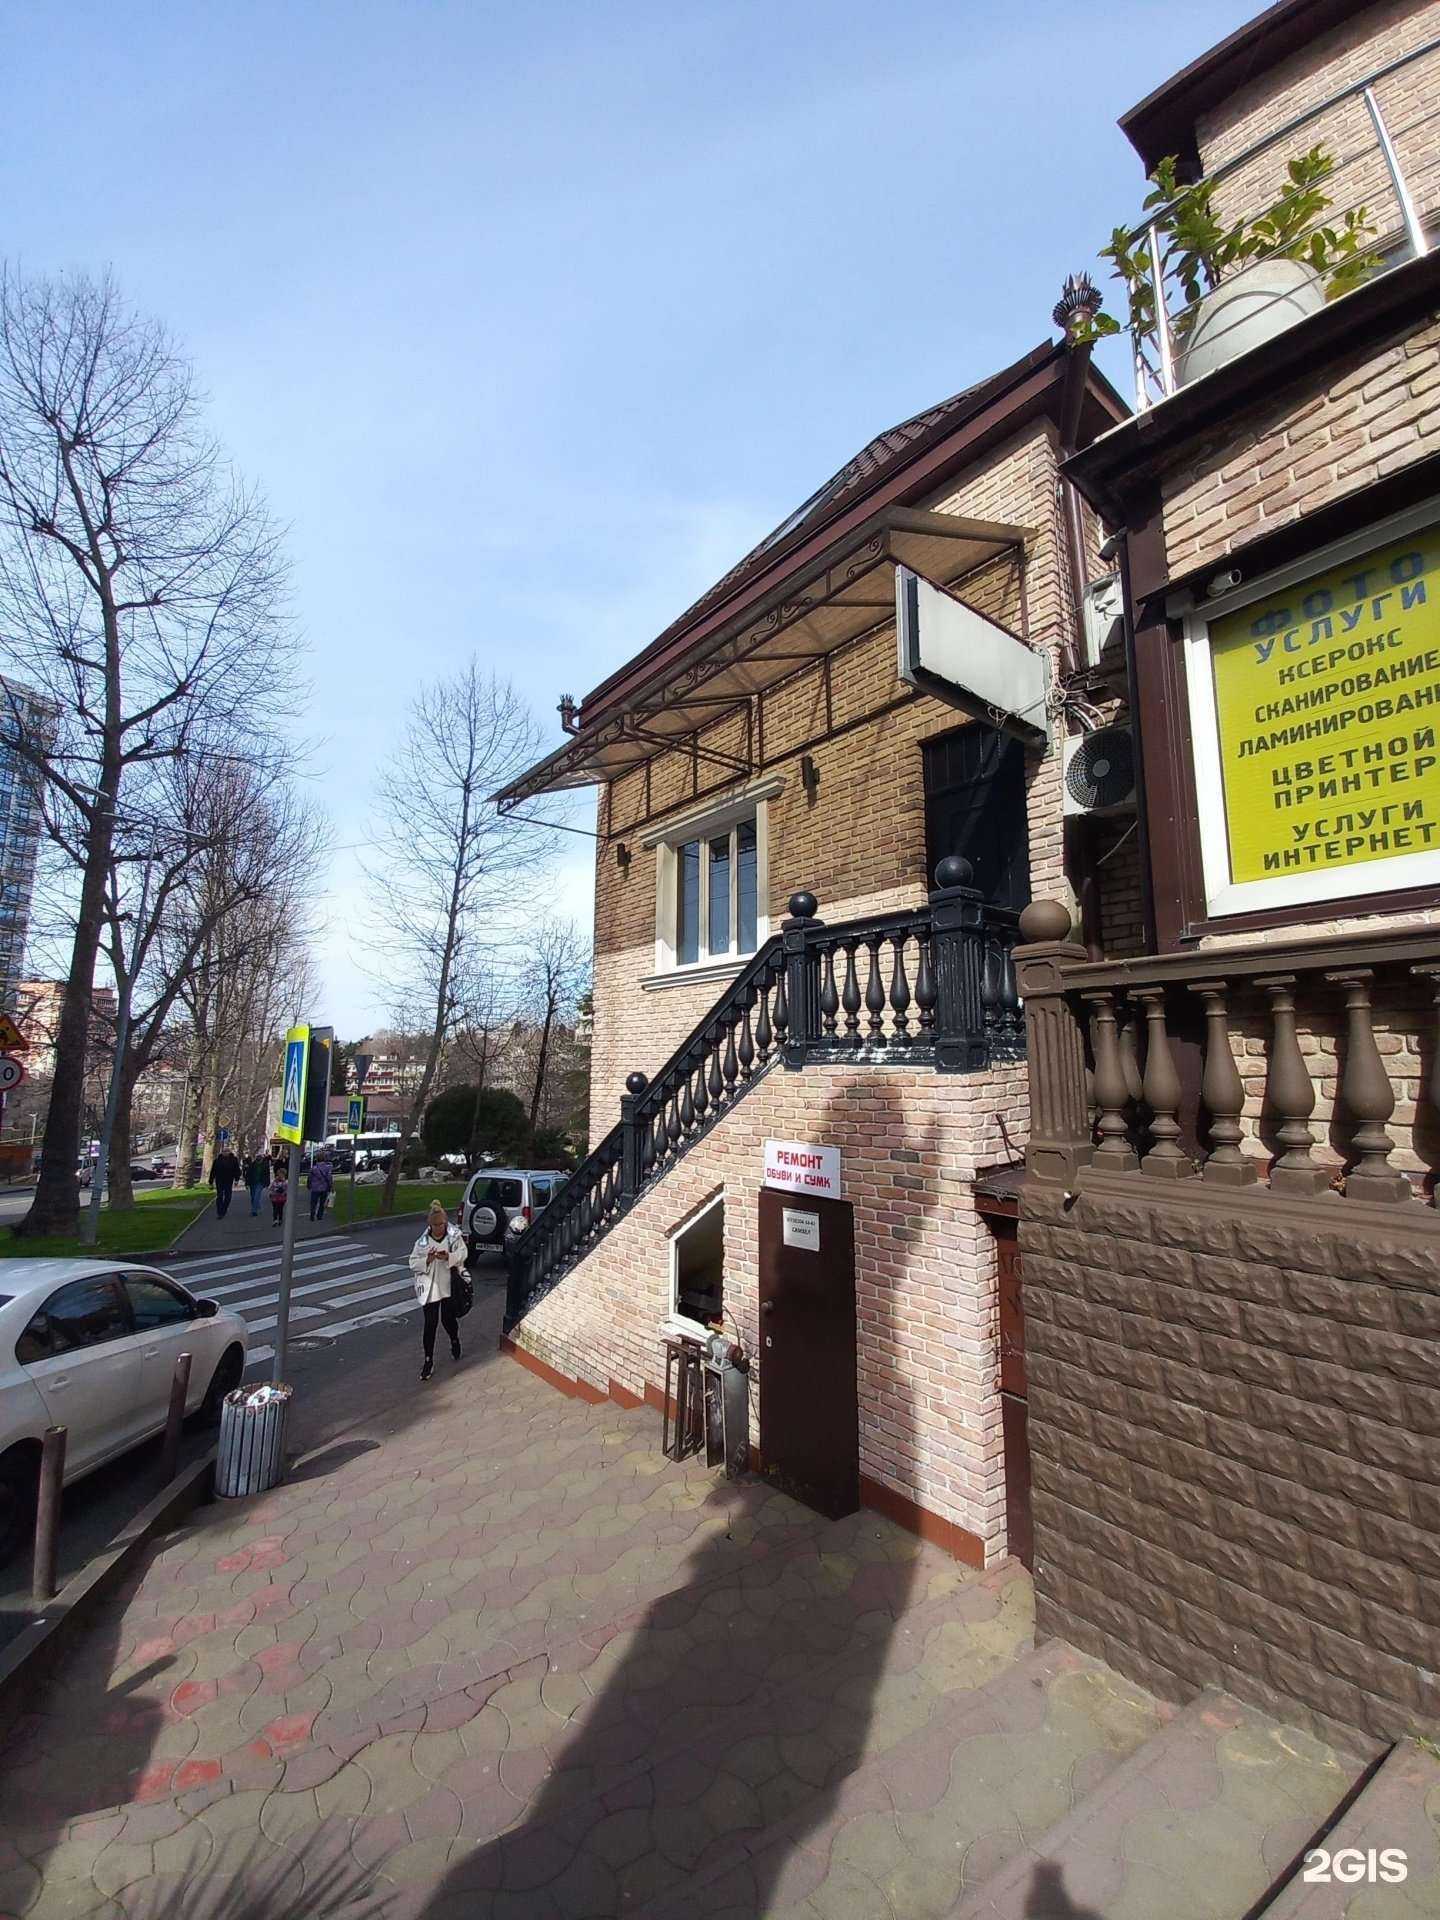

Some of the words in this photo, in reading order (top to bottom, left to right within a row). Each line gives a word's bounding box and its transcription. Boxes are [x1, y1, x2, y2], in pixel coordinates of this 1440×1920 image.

[1250, 551, 1424, 637] ФОТО
[1254, 580, 1427, 665] УСЛУГИ
[1278, 627, 1403, 686] КСЕРОКС
[1254, 649, 1440, 723] СКАНИРОВАНИЕ
[1271, 726, 1435, 787] ЦВЕТНОЙ
[1274, 755, 1436, 809] ПРИНТЕР
[1263, 822, 1437, 871] ИНТЕРНЕТ
[1292, 799, 1424, 842] УСЛУГИ
[766, 1167, 792, 1181] ОБУВИ
[795, 1172, 801, 1183] И
[804, 1174, 831, 1188] СУМК
[777, 1150, 823, 1169] РЕМОНТ
